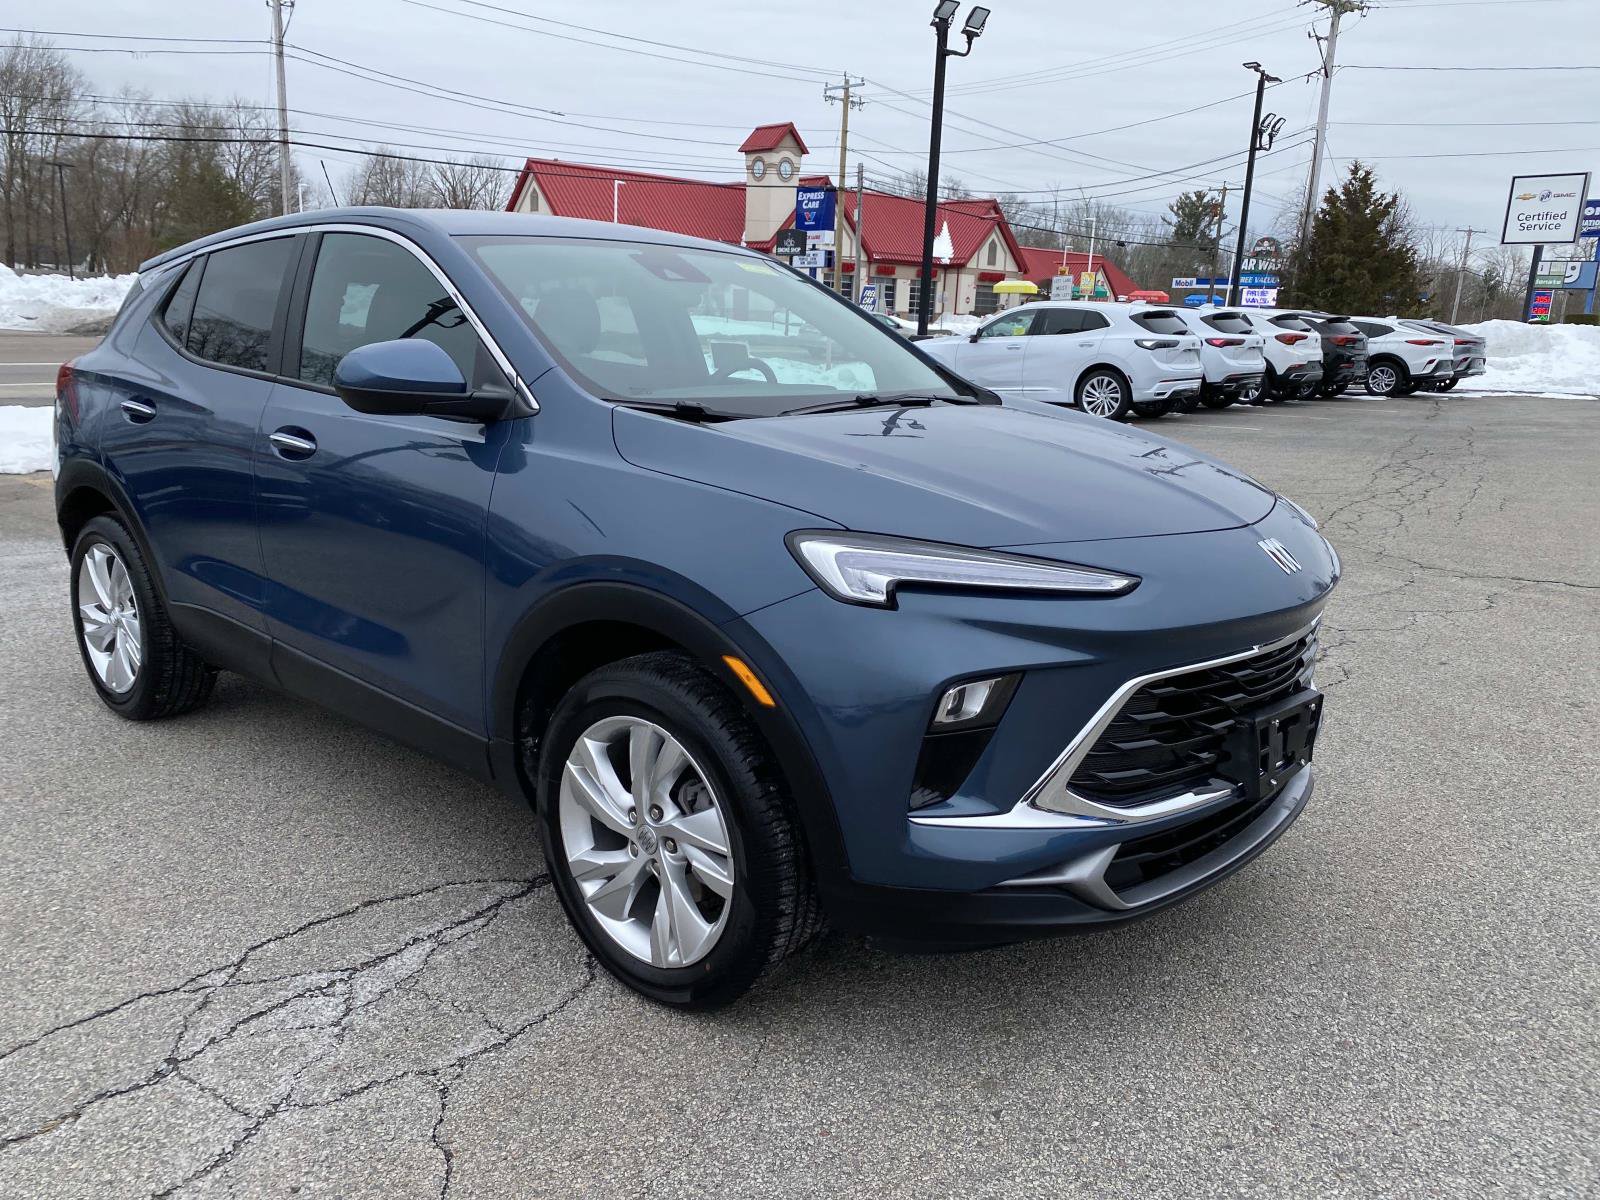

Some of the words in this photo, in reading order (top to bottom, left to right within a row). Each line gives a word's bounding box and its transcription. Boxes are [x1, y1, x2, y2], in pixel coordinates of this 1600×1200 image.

[797, 191, 825, 201] EXPRESS
[802, 200, 820, 209] CARE
[1517, 210, 1568, 222] Certified
[1518, 221, 1562, 232] Service
[1241, 258, 1257, 271] AR
[1174, 279, 1194, 287] Mobil
